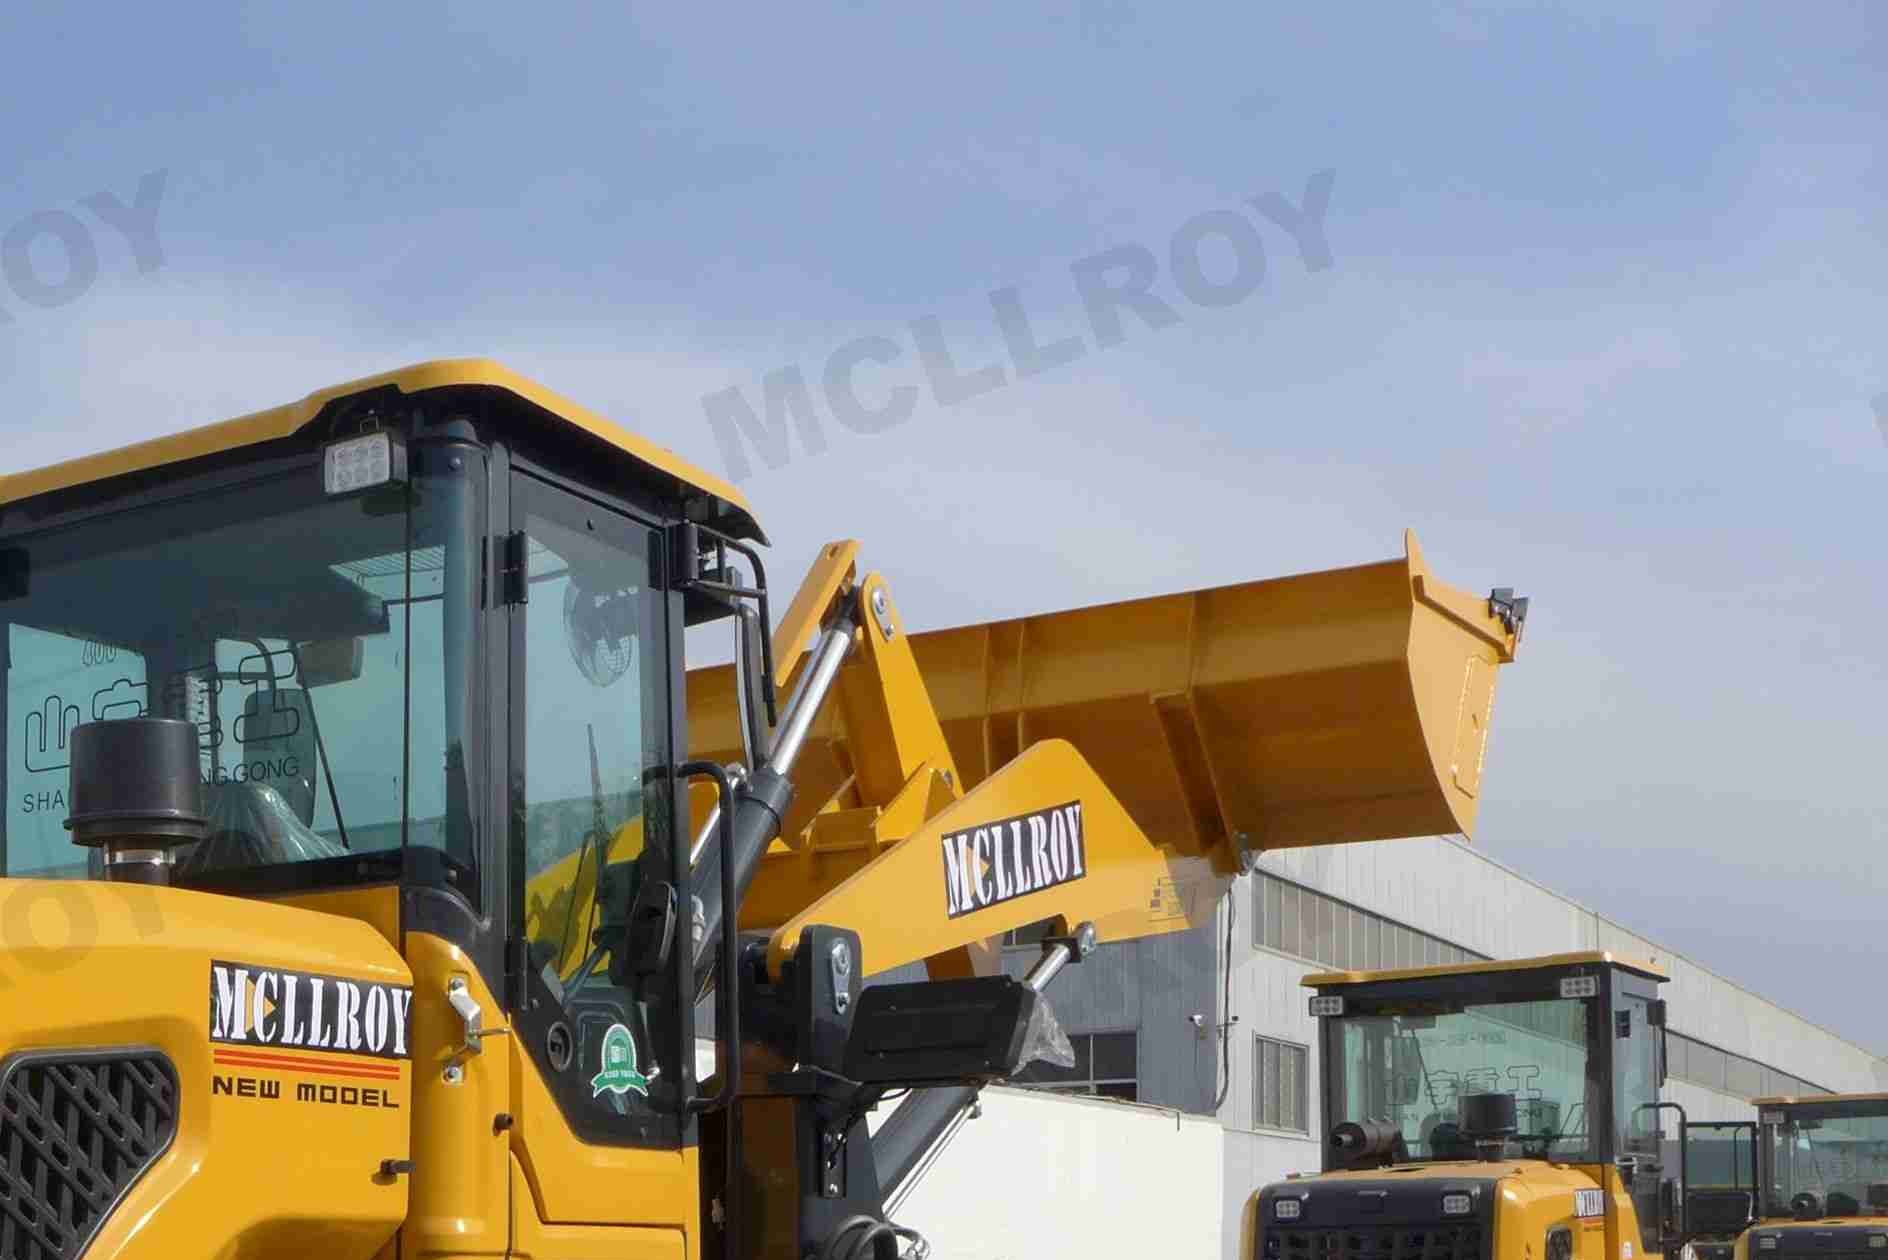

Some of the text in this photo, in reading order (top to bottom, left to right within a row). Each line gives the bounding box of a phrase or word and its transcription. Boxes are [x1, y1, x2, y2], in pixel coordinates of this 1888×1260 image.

[23, 791, 66, 813] SHA
[943, 805, 1083, 914] MCLLROY
[212, 966, 411, 1056] MCLLROY
[213, 1076, 399, 1108] NEW MODEL
